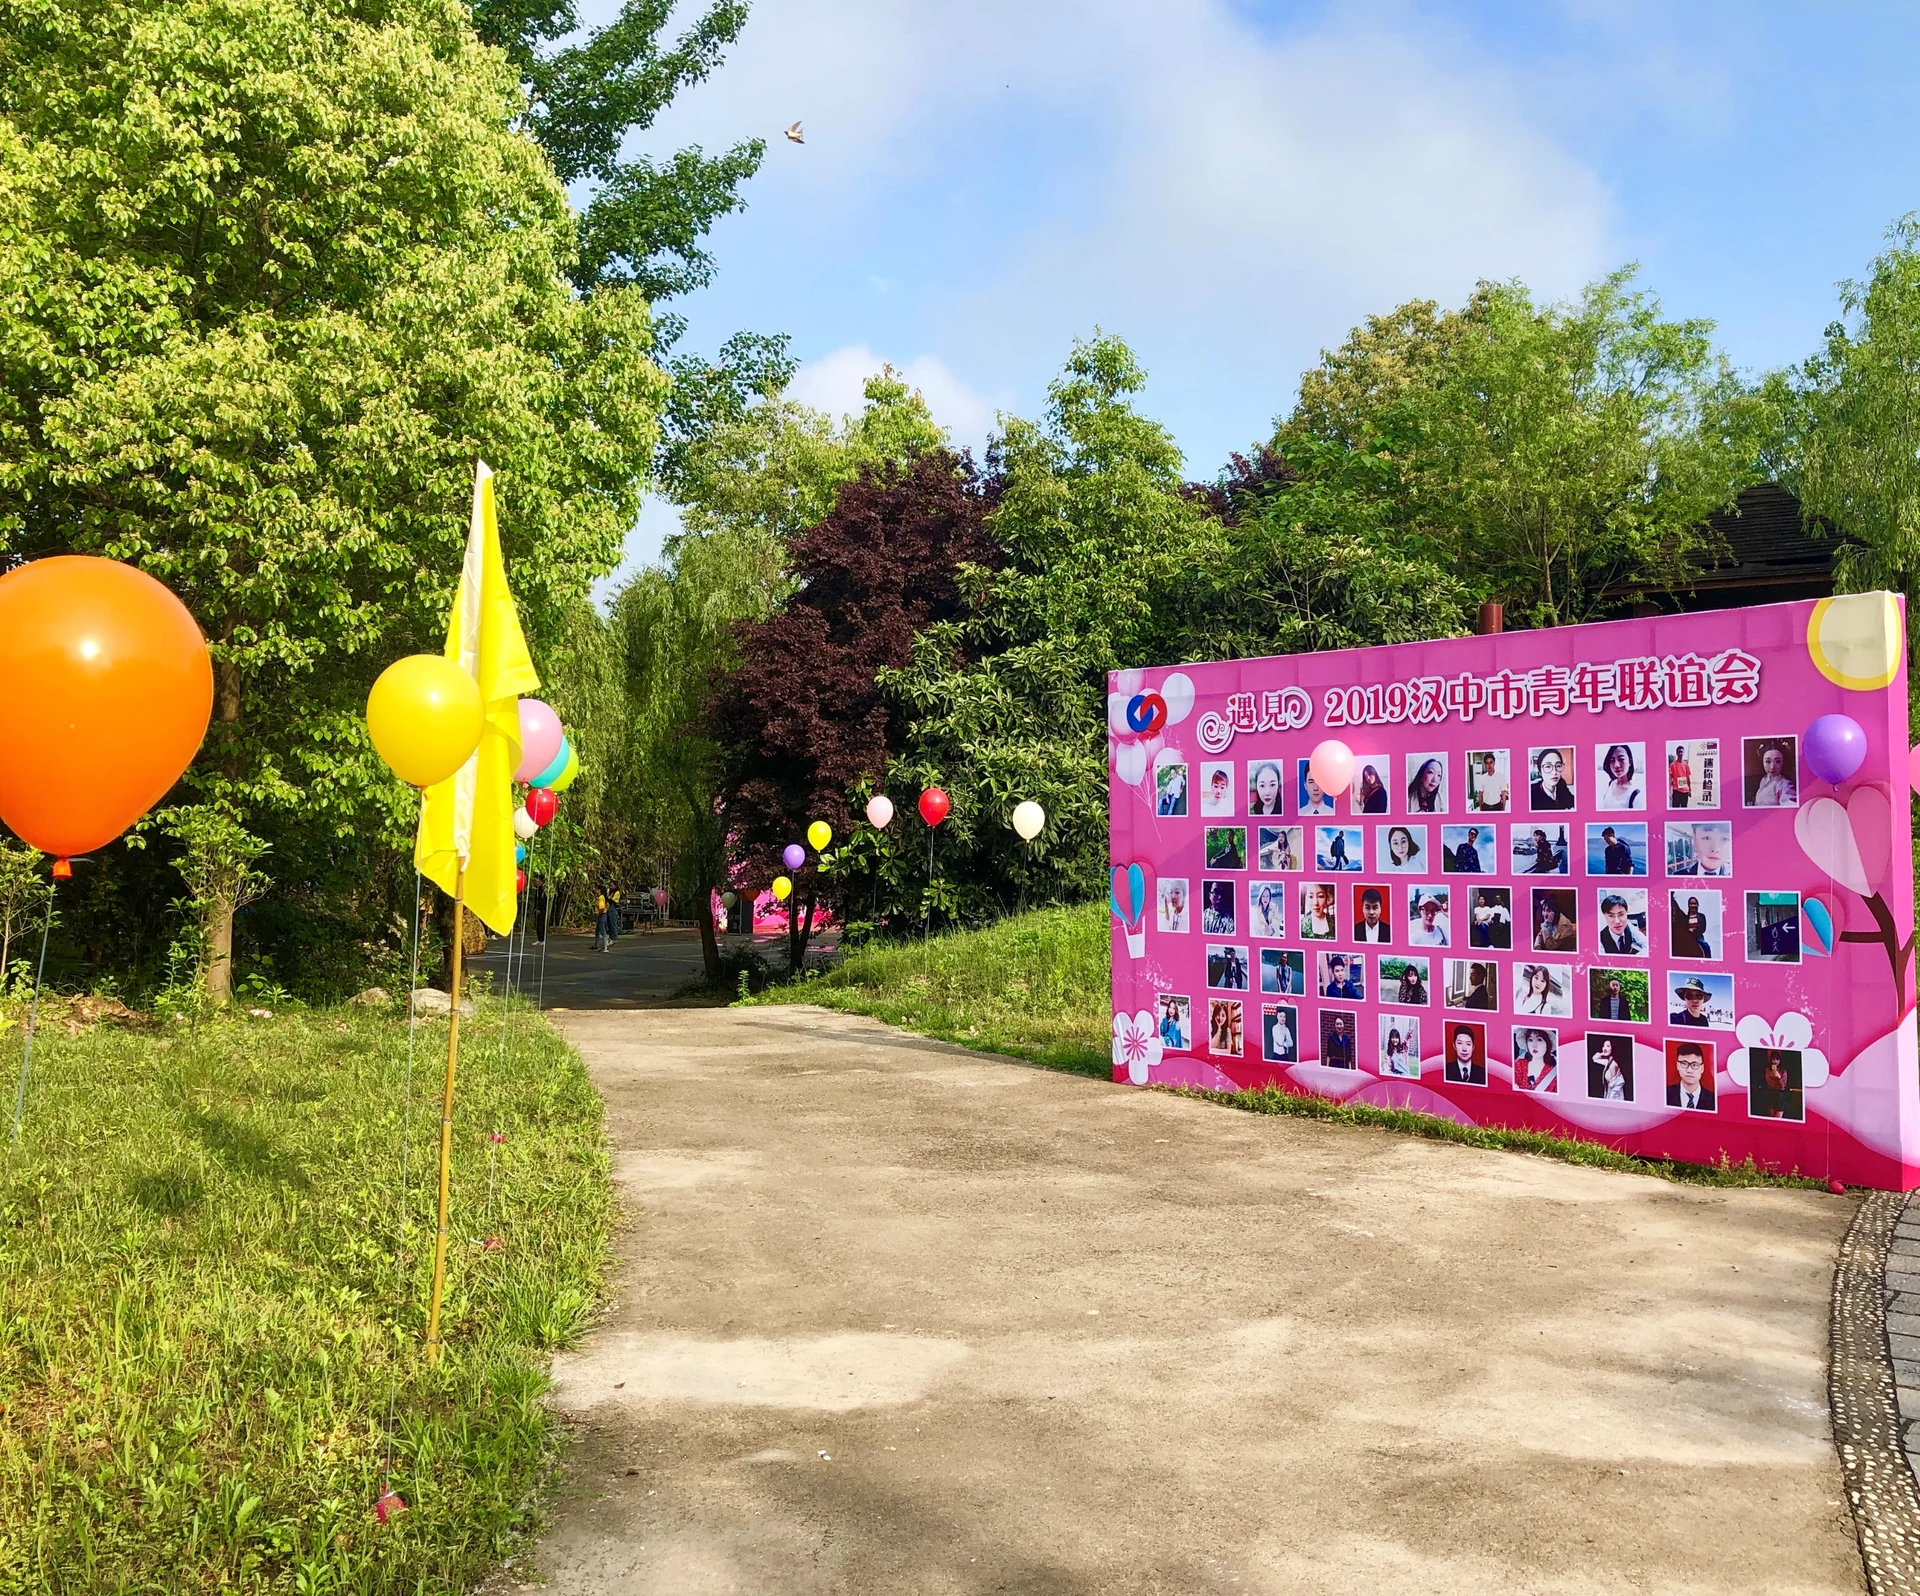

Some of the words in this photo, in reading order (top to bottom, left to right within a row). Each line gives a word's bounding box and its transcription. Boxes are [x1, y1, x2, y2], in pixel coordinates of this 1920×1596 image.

[1203, 688, 1308, 746] 遇見
[1326, 652, 1758, 724] 2019汉中市青年联谊会
